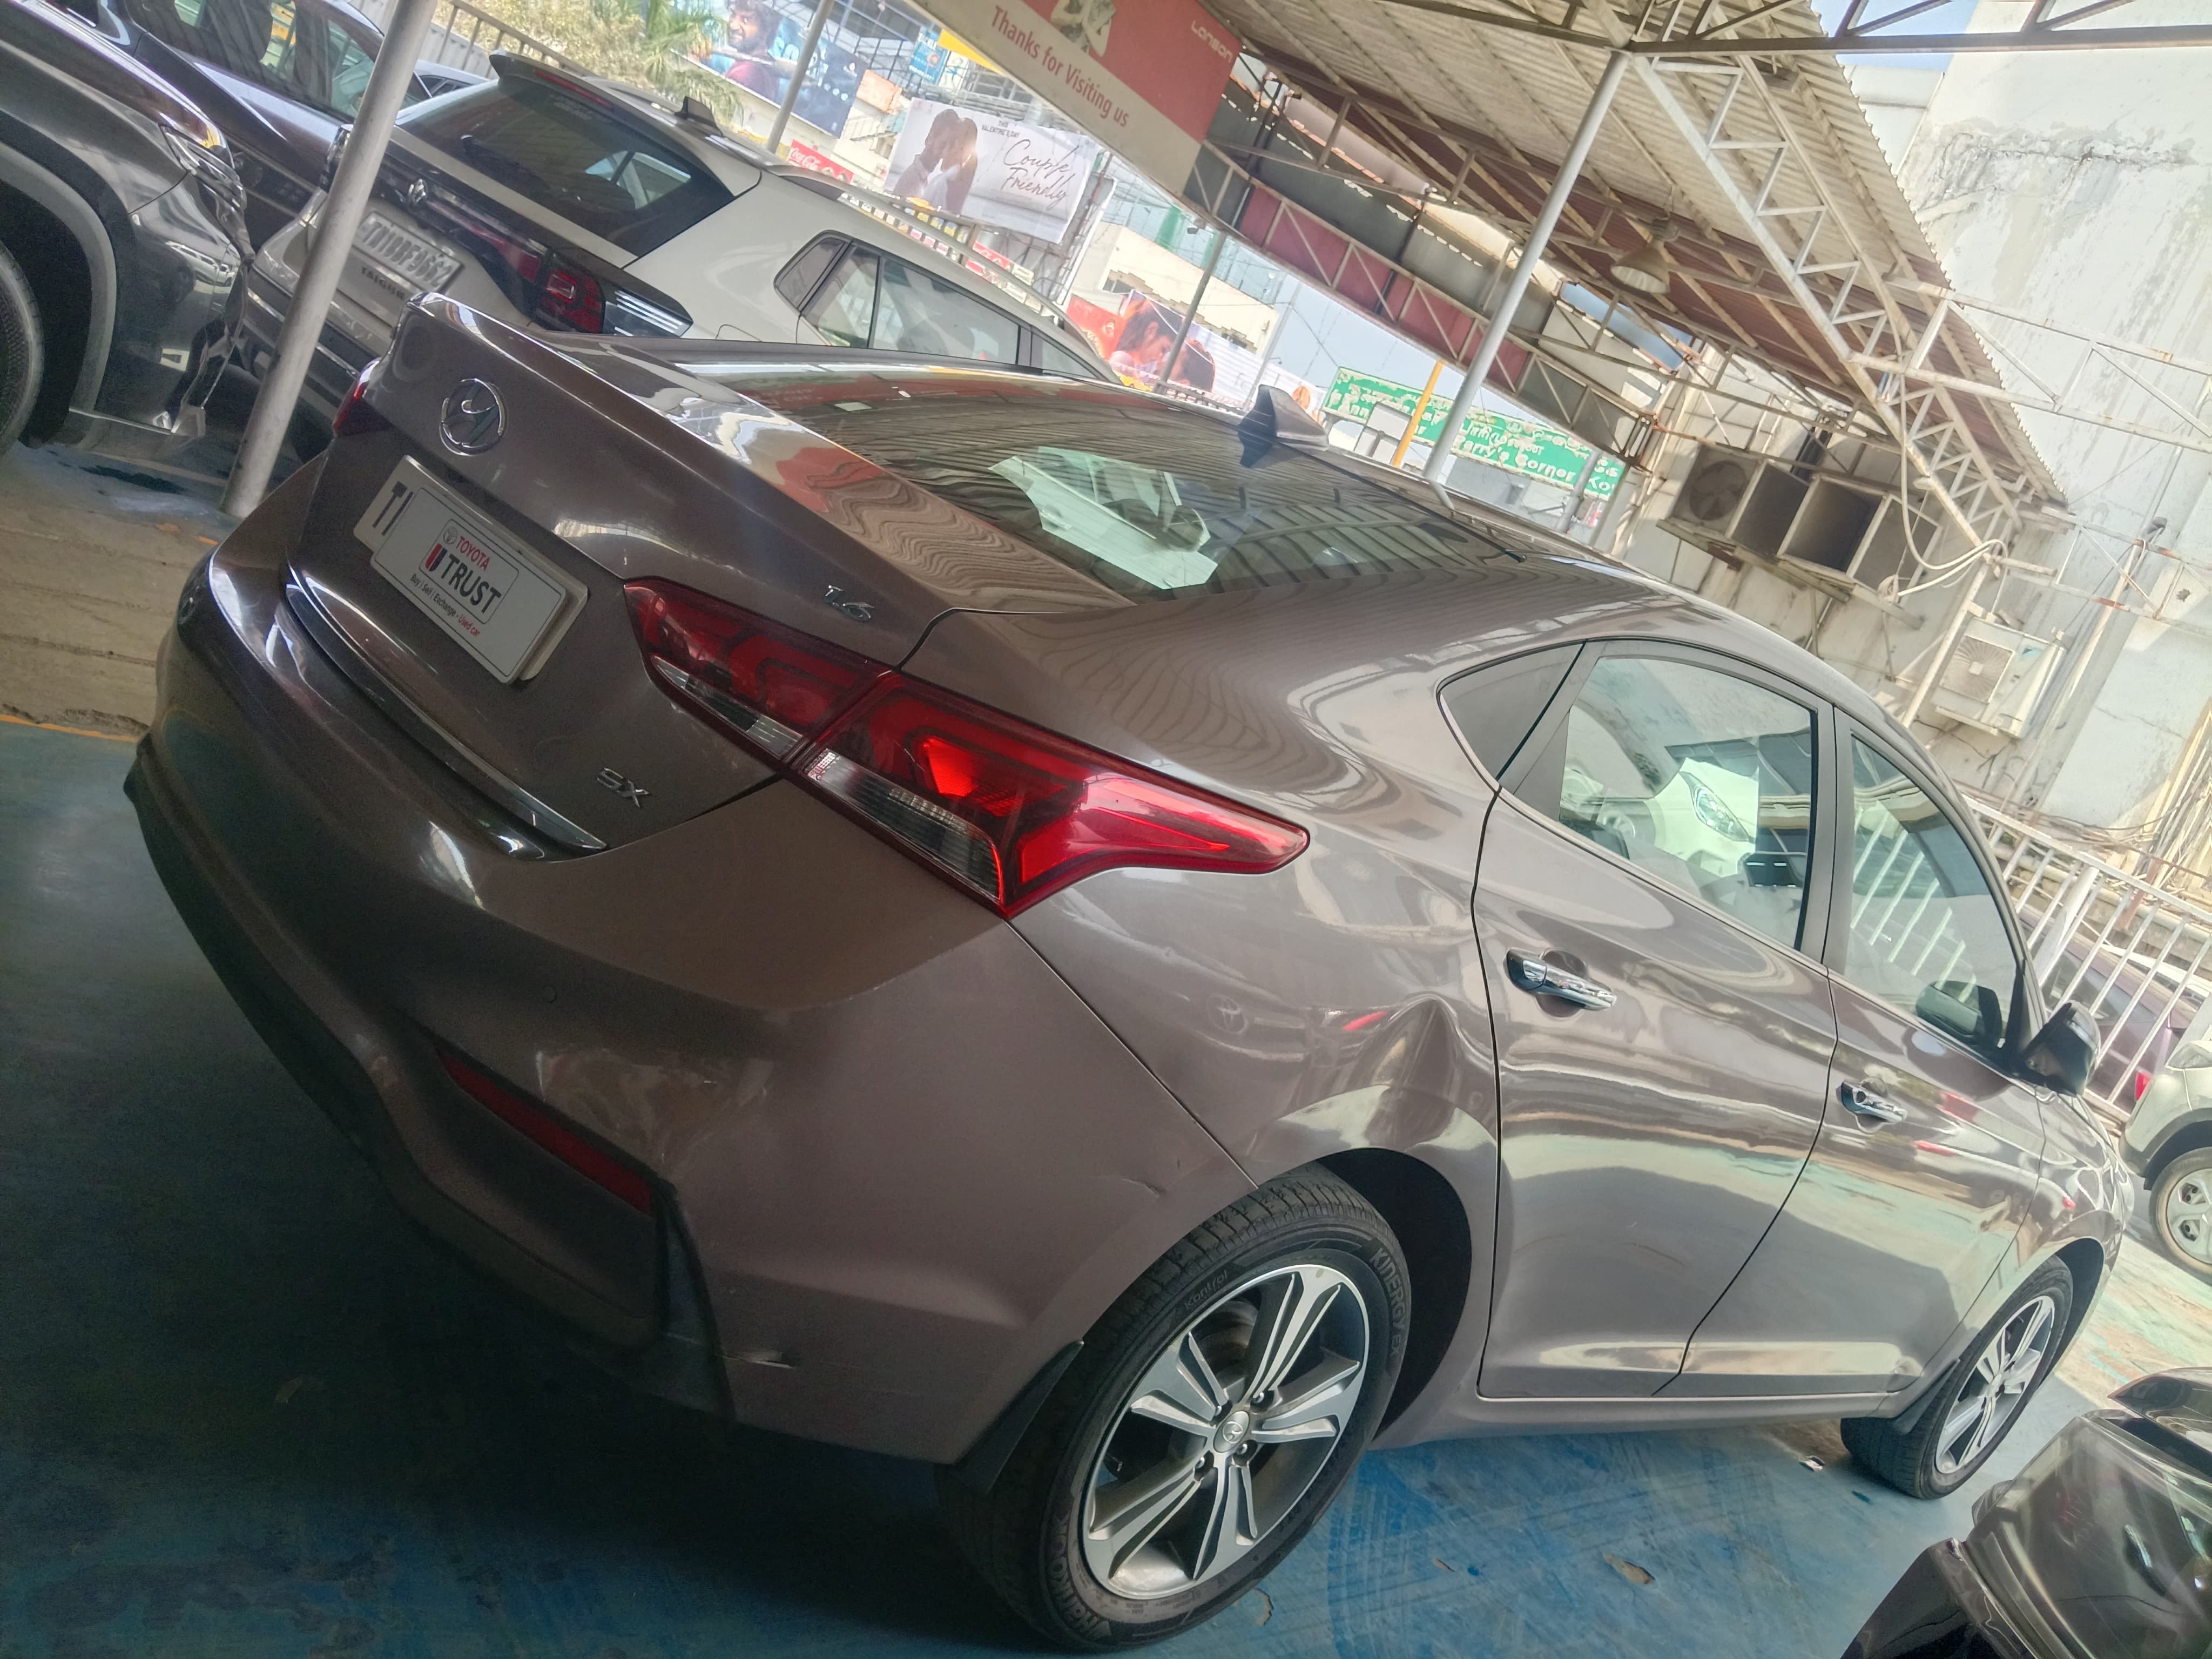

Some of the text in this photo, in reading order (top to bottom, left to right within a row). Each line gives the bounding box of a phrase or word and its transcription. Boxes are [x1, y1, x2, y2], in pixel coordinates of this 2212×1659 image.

[990, 5, 1130, 127] Thanks for Visiting us
[1003, 139, 1080, 179] Couple
[1001, 167, 1076, 211] Friendly
[456, 536, 490, 571] TOYOTA
[410, 573, 421, 587] Buy
[421, 583, 433, 595] Sell
[433, 595, 457, 617] Exchange
[458, 614, 474, 630] Used
[470, 626, 481, 637] car
[822, 585, 875, 622] 1.6
[597, 767, 650, 808] SX
